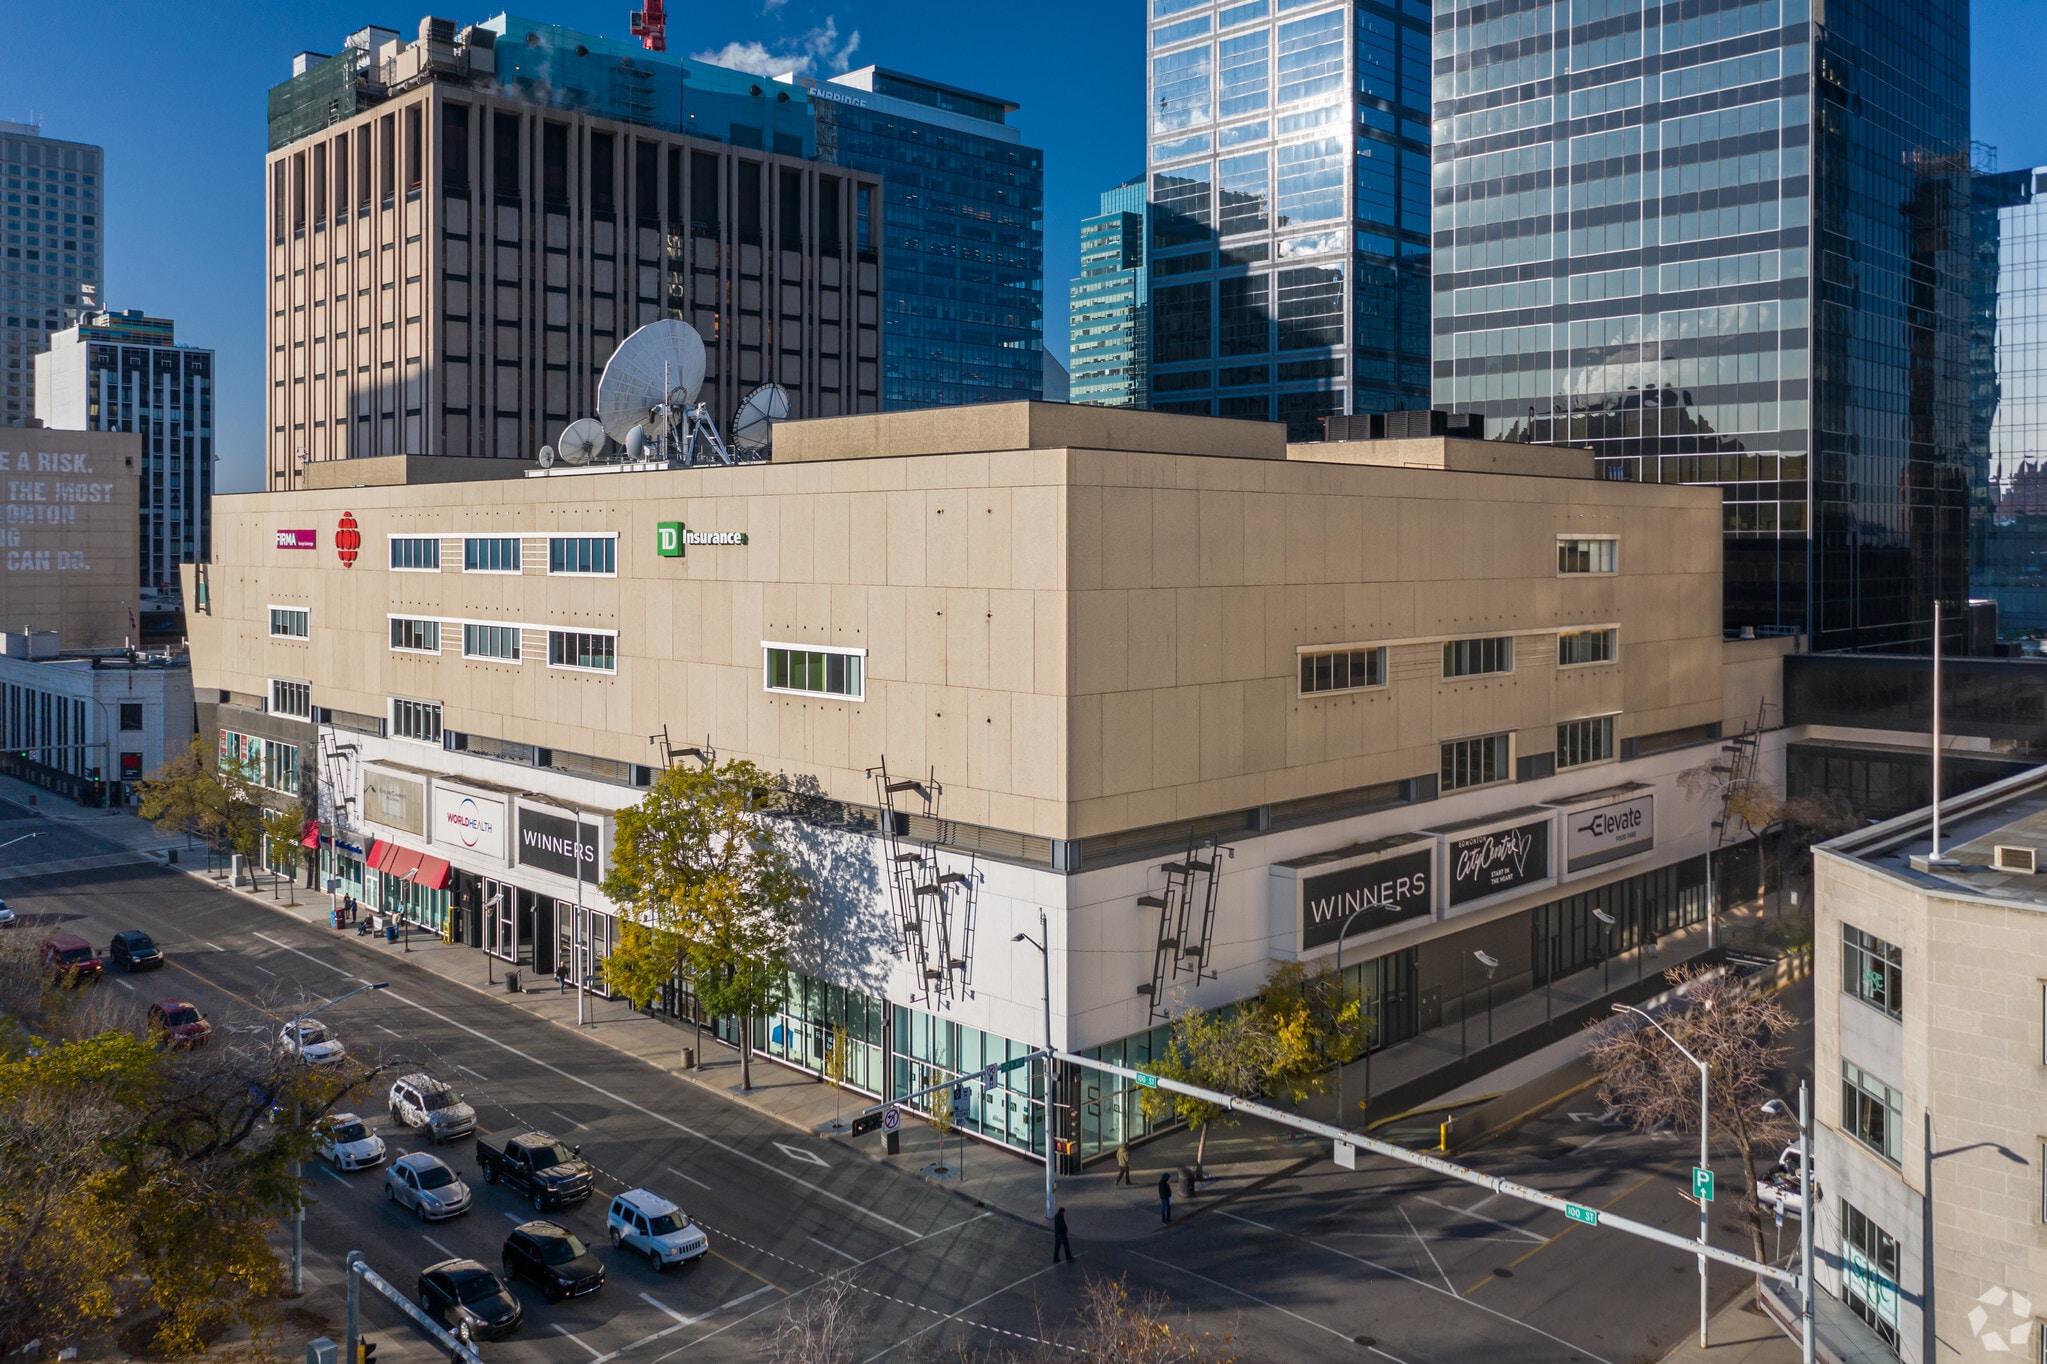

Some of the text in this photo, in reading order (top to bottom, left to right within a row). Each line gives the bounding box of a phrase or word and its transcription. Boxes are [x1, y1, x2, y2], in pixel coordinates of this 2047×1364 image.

[17, 451, 31, 471] A
[38, 452, 93, 473] RISK.
[8, 481, 113, 503] THE MOST
[276, 533, 296, 546] FIRMA
[658, 528, 742, 550] TD Insurance
[7, 550, 91, 571] CAN DO.
[1578, 808, 1642, 837] Elevate
[523, 828, 595, 862] WINNERS
[1311, 873, 1425, 923] WINNERS
[1697, 1170, 1710, 1187] P
[1568, 1206, 1595, 1222] 100 ST
